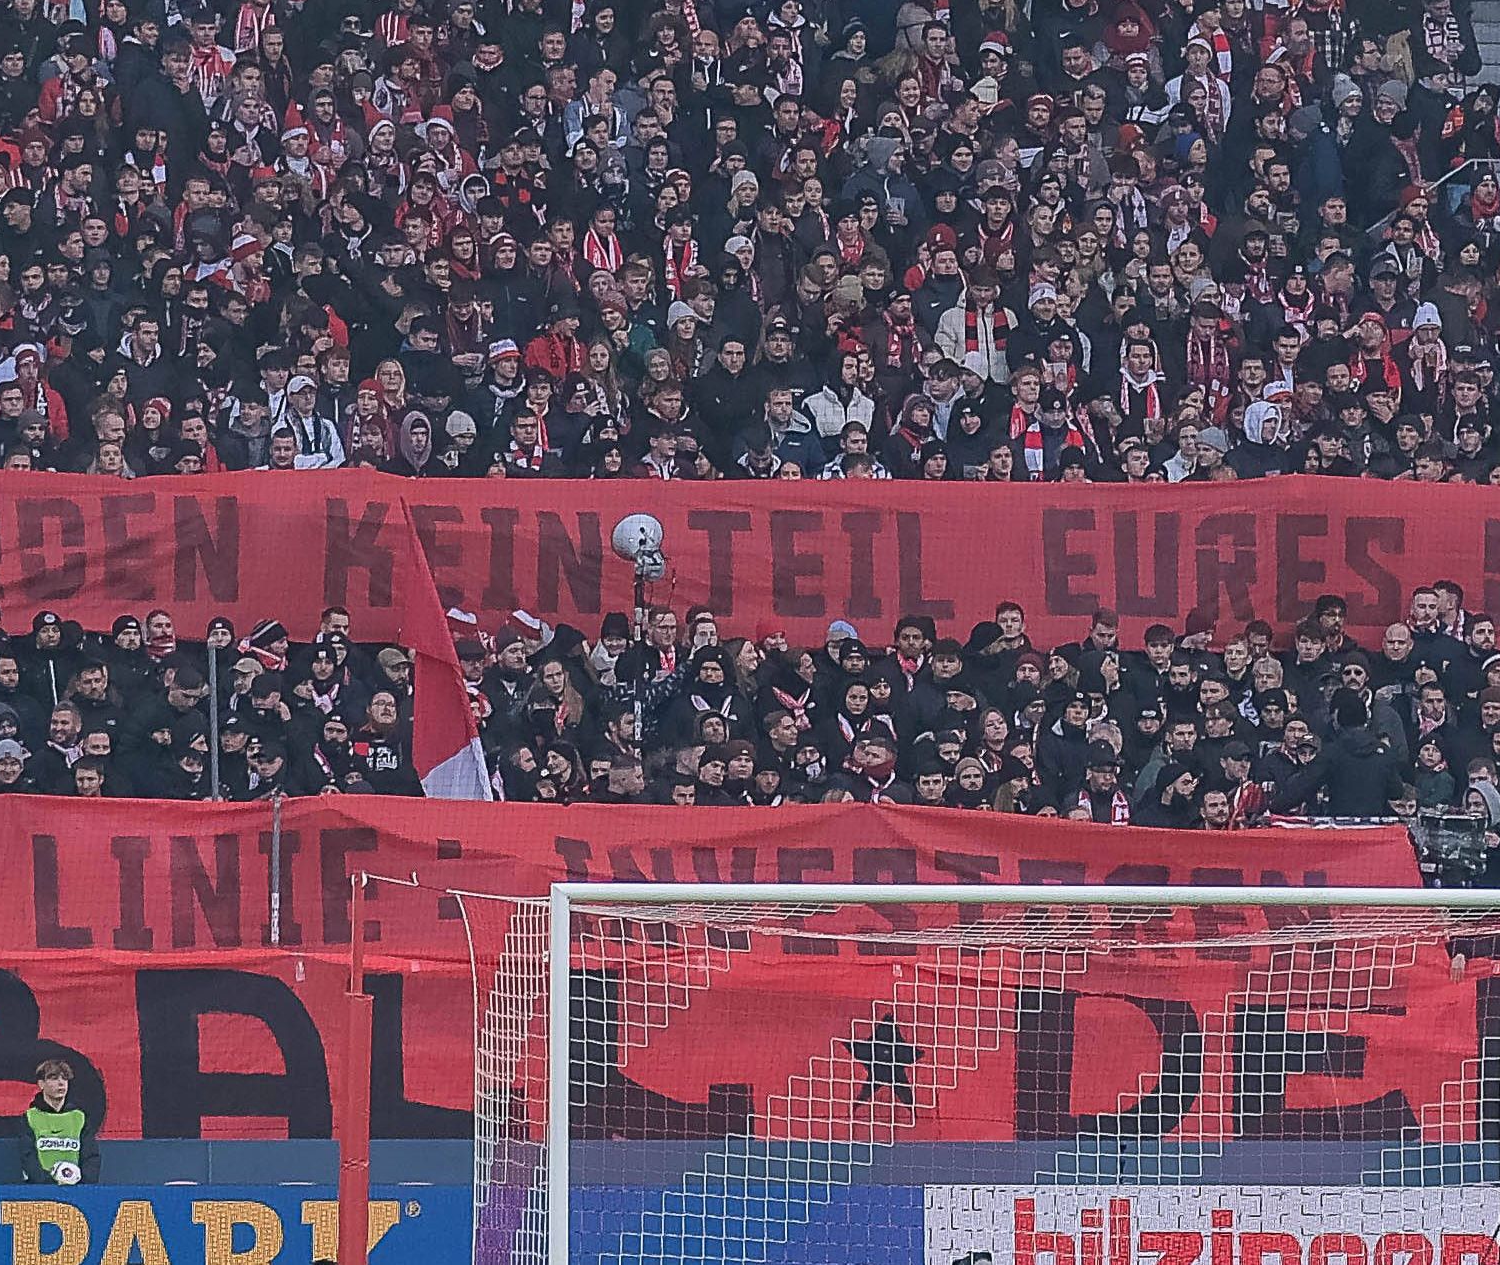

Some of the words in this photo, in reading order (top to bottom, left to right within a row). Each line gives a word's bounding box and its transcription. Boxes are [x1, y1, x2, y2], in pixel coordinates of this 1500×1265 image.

[323, 498, 604, 615] KEIN
[687, 508, 957, 620] TEIL
[1042, 508, 1406, 626] EURES
